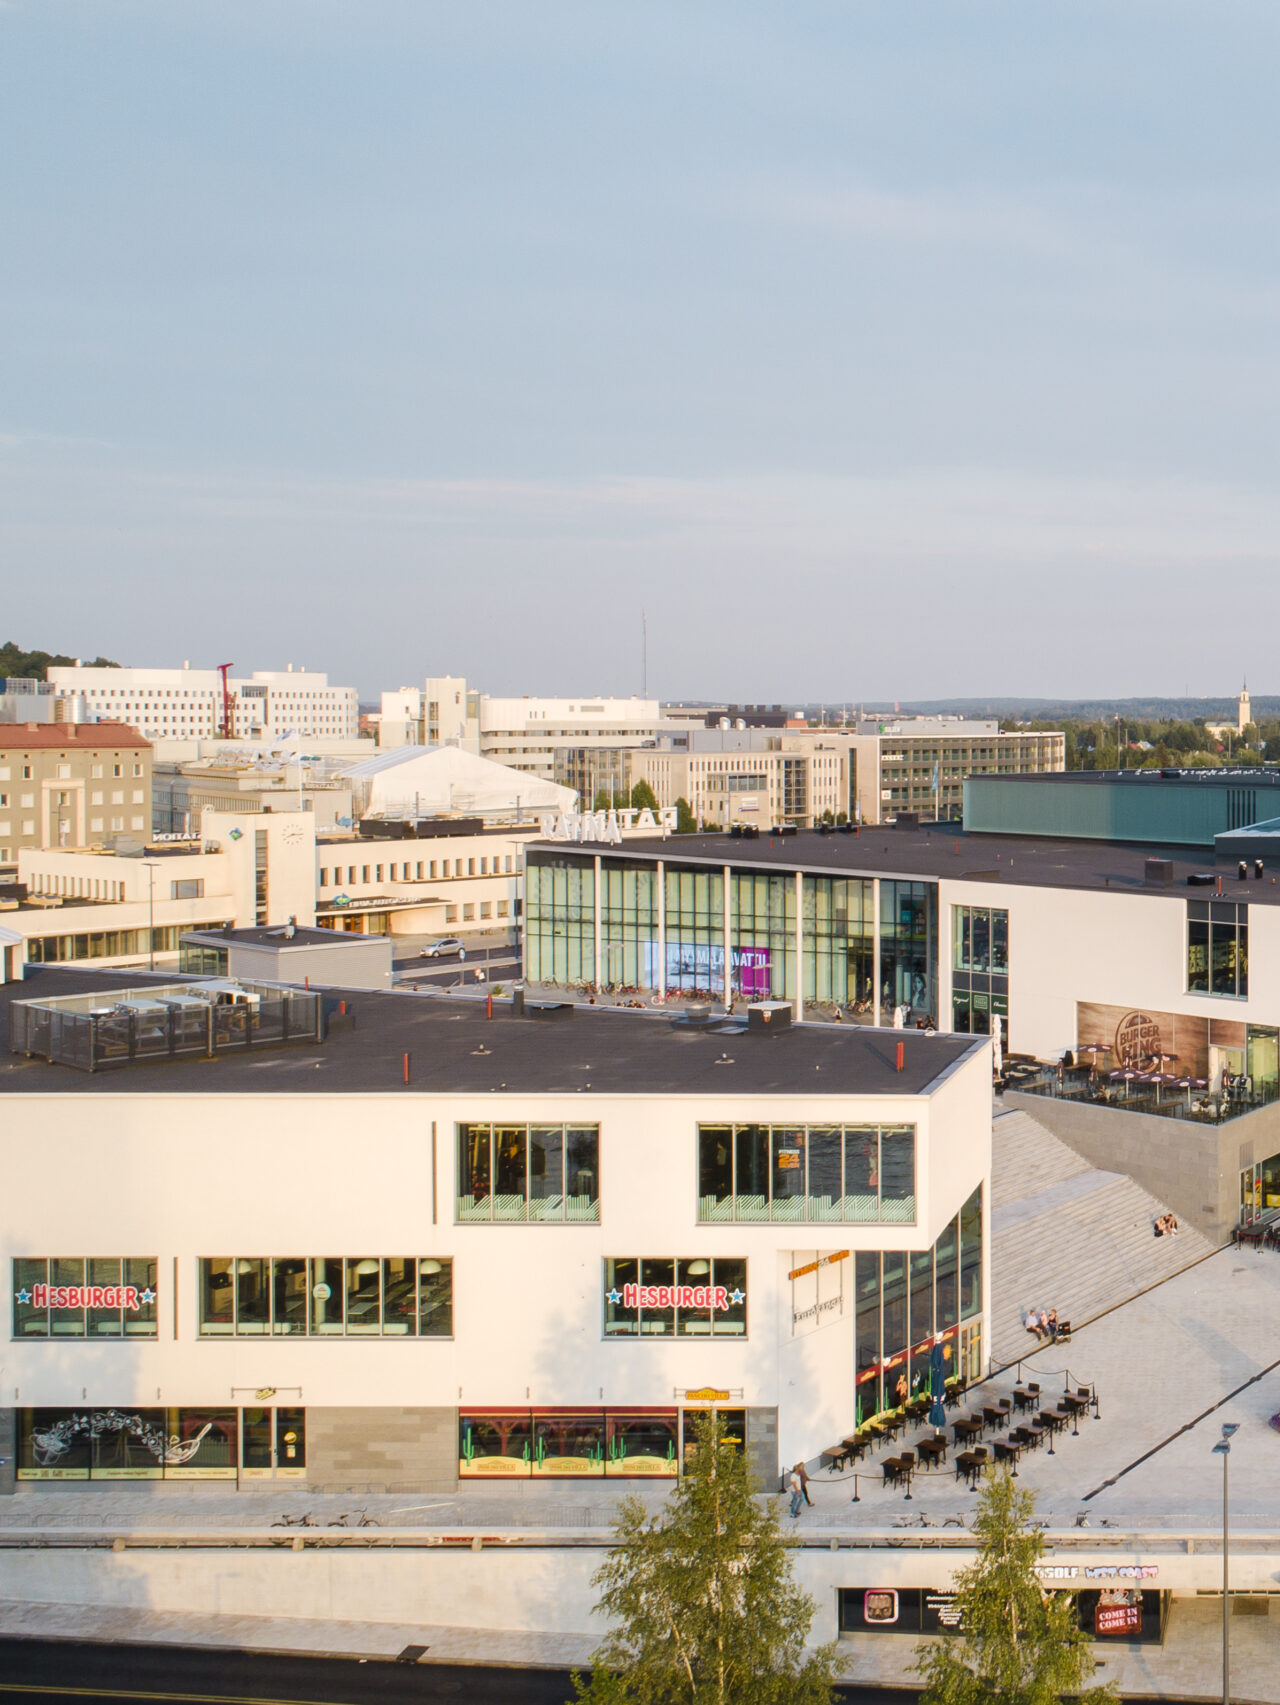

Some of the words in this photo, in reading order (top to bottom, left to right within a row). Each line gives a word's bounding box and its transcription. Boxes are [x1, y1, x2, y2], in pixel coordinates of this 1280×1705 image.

[540, 813, 622, 843] RATINA
[1120, 1025, 1159, 1046] BURGER
[1122, 1038, 1161, 1061] KING
[779, 1154, 799, 1162] 24
[33, 1284, 139, 1311] HESBURGER
[624, 1283, 729, 1311] HESBURGER
[1119, 1566, 1158, 1579] COAST
[1099, 1609, 1126, 1621] COME
[1127, 1606, 1138, 1616] IN
[1099, 1619, 1126, 1630] COME
[1127, 1616, 1138, 1625] IN
